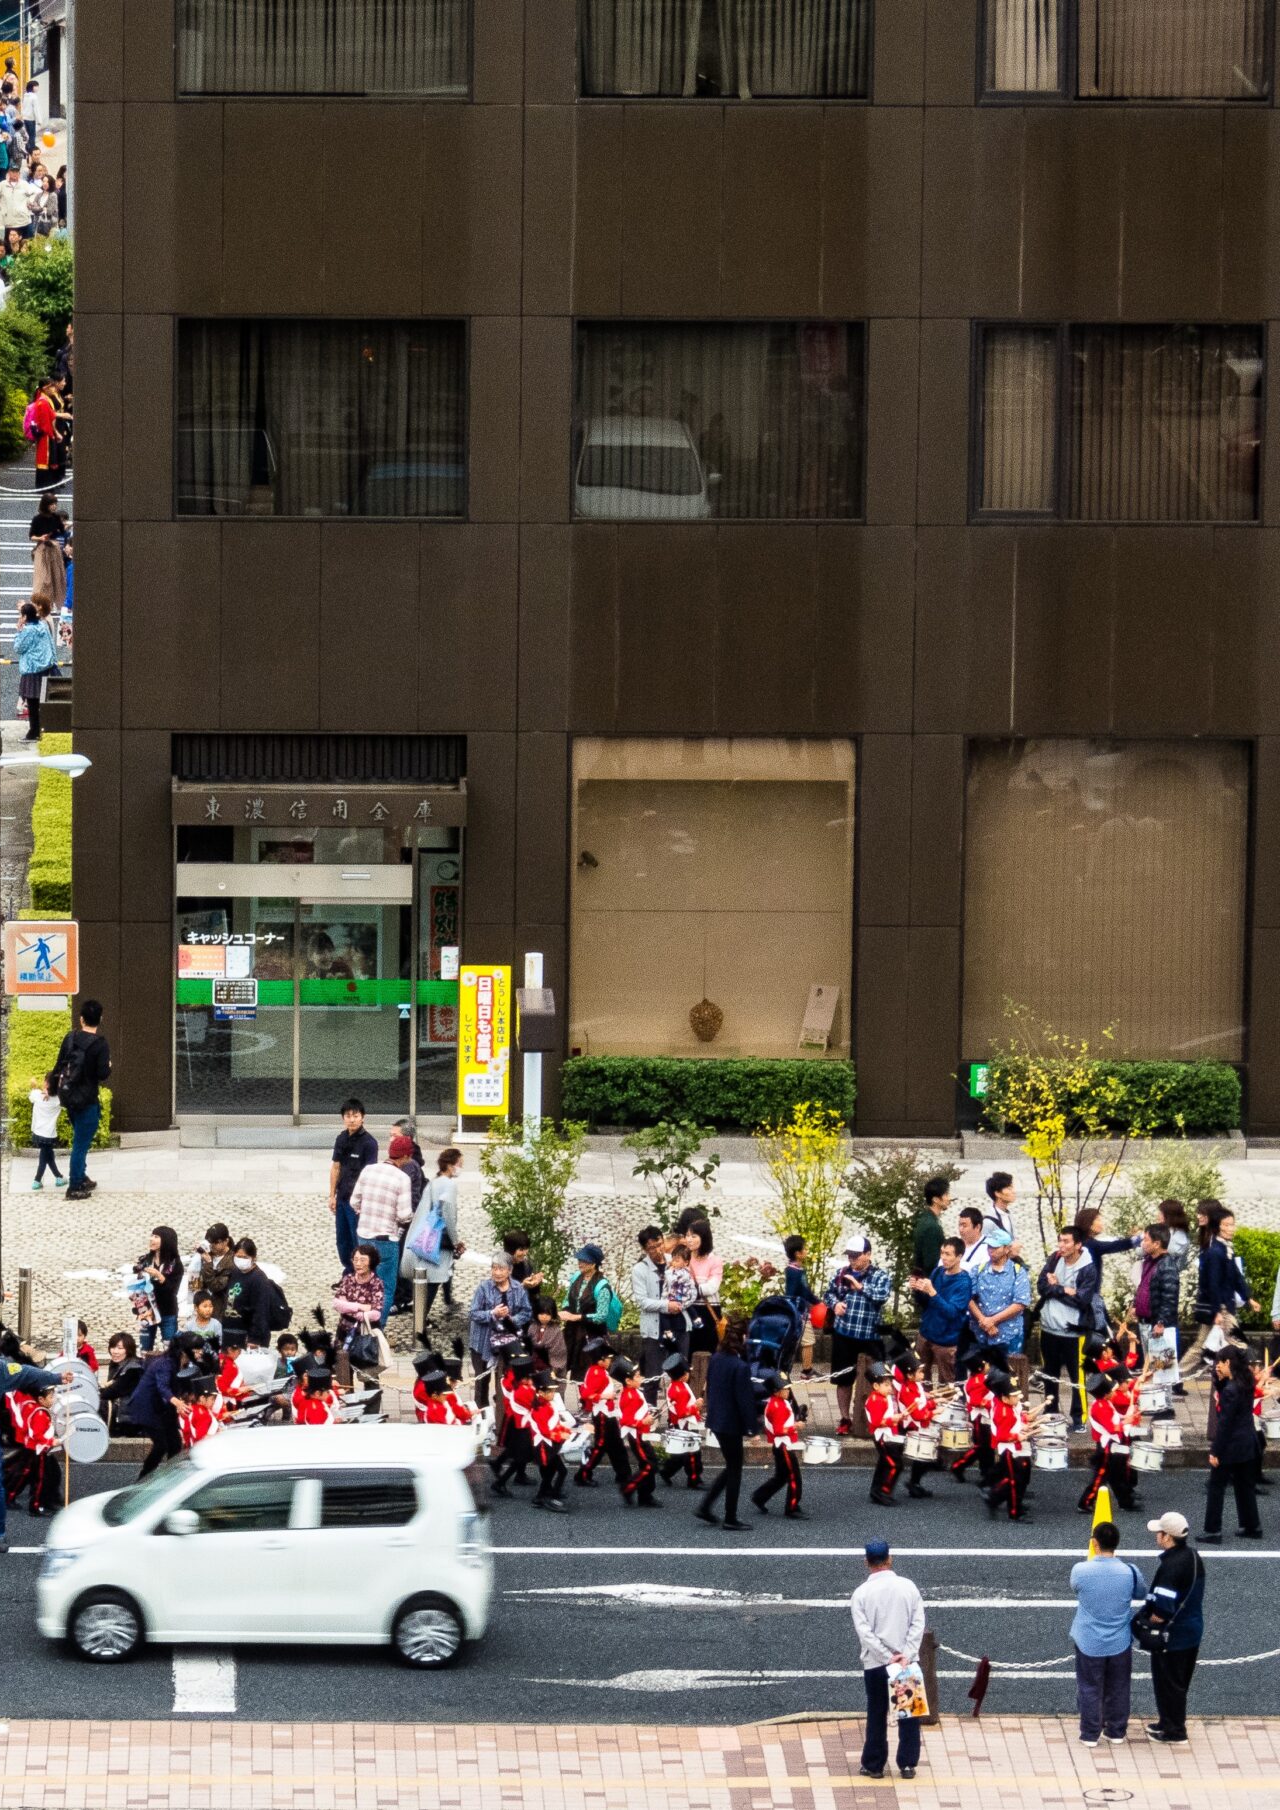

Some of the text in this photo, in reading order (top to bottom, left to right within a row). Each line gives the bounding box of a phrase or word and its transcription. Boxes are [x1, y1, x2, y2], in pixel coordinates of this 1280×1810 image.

[204, 796, 433, 821] 東濃信用金庫
[187, 931, 285, 945] キャッシュコーナー
[497, 978, 506, 1043] とうしん本店は
[465, 1013, 473, 1063] しています
